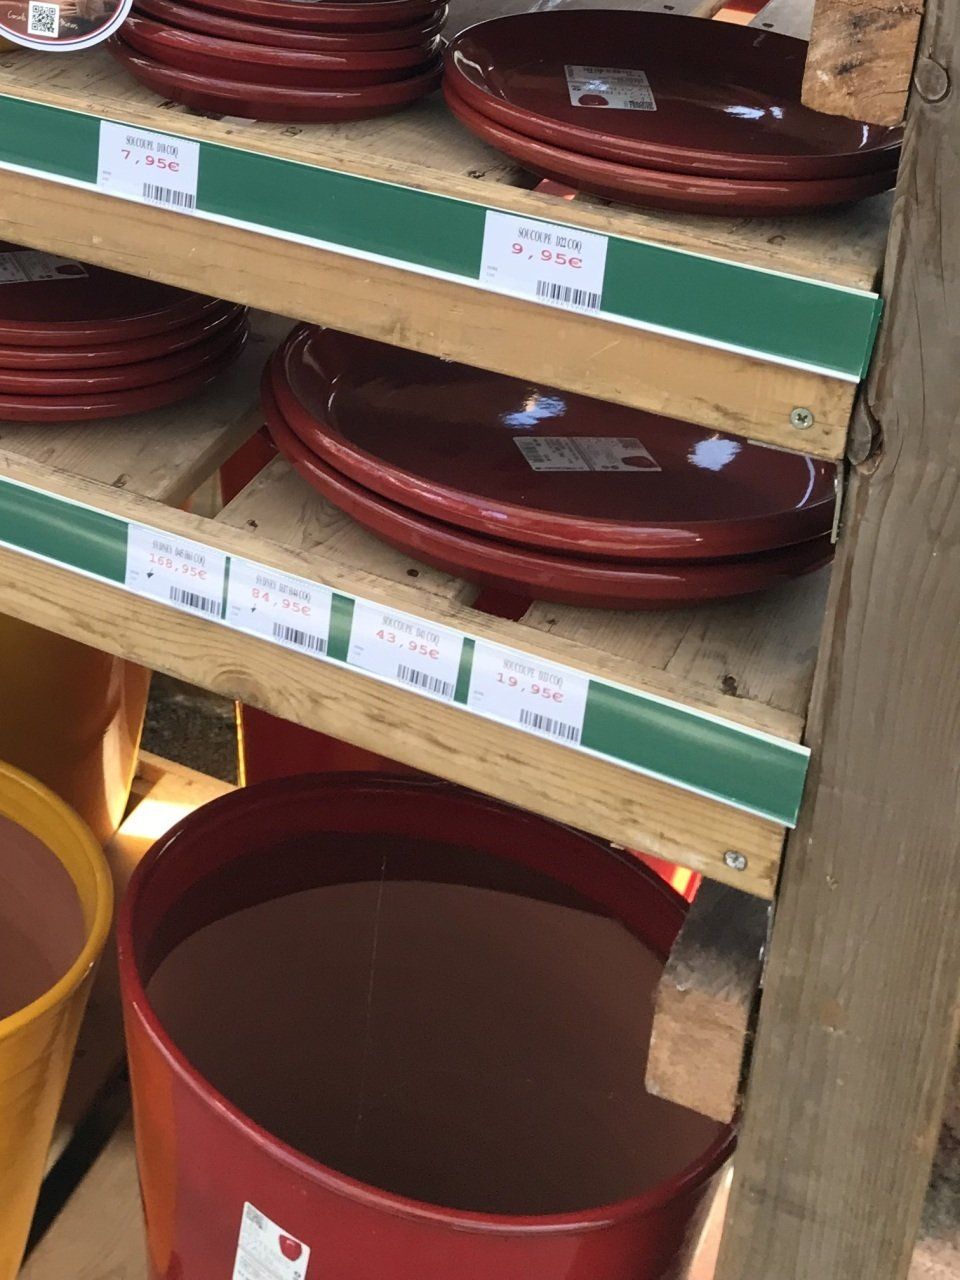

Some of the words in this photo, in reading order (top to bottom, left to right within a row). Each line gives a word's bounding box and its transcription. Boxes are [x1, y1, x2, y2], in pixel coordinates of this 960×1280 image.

[121, 149, 180, 172] 7,95€
[518, 226, 552, 245] SOUCOUPE
[511, 242, 583, 269] 9,95€
[149, 552, 208, 581] 168,95€
[250, 587, 312, 617] 84,95€
[375, 628, 440, 661] 43,95€
[496, 671, 566, 705] 19,95€
